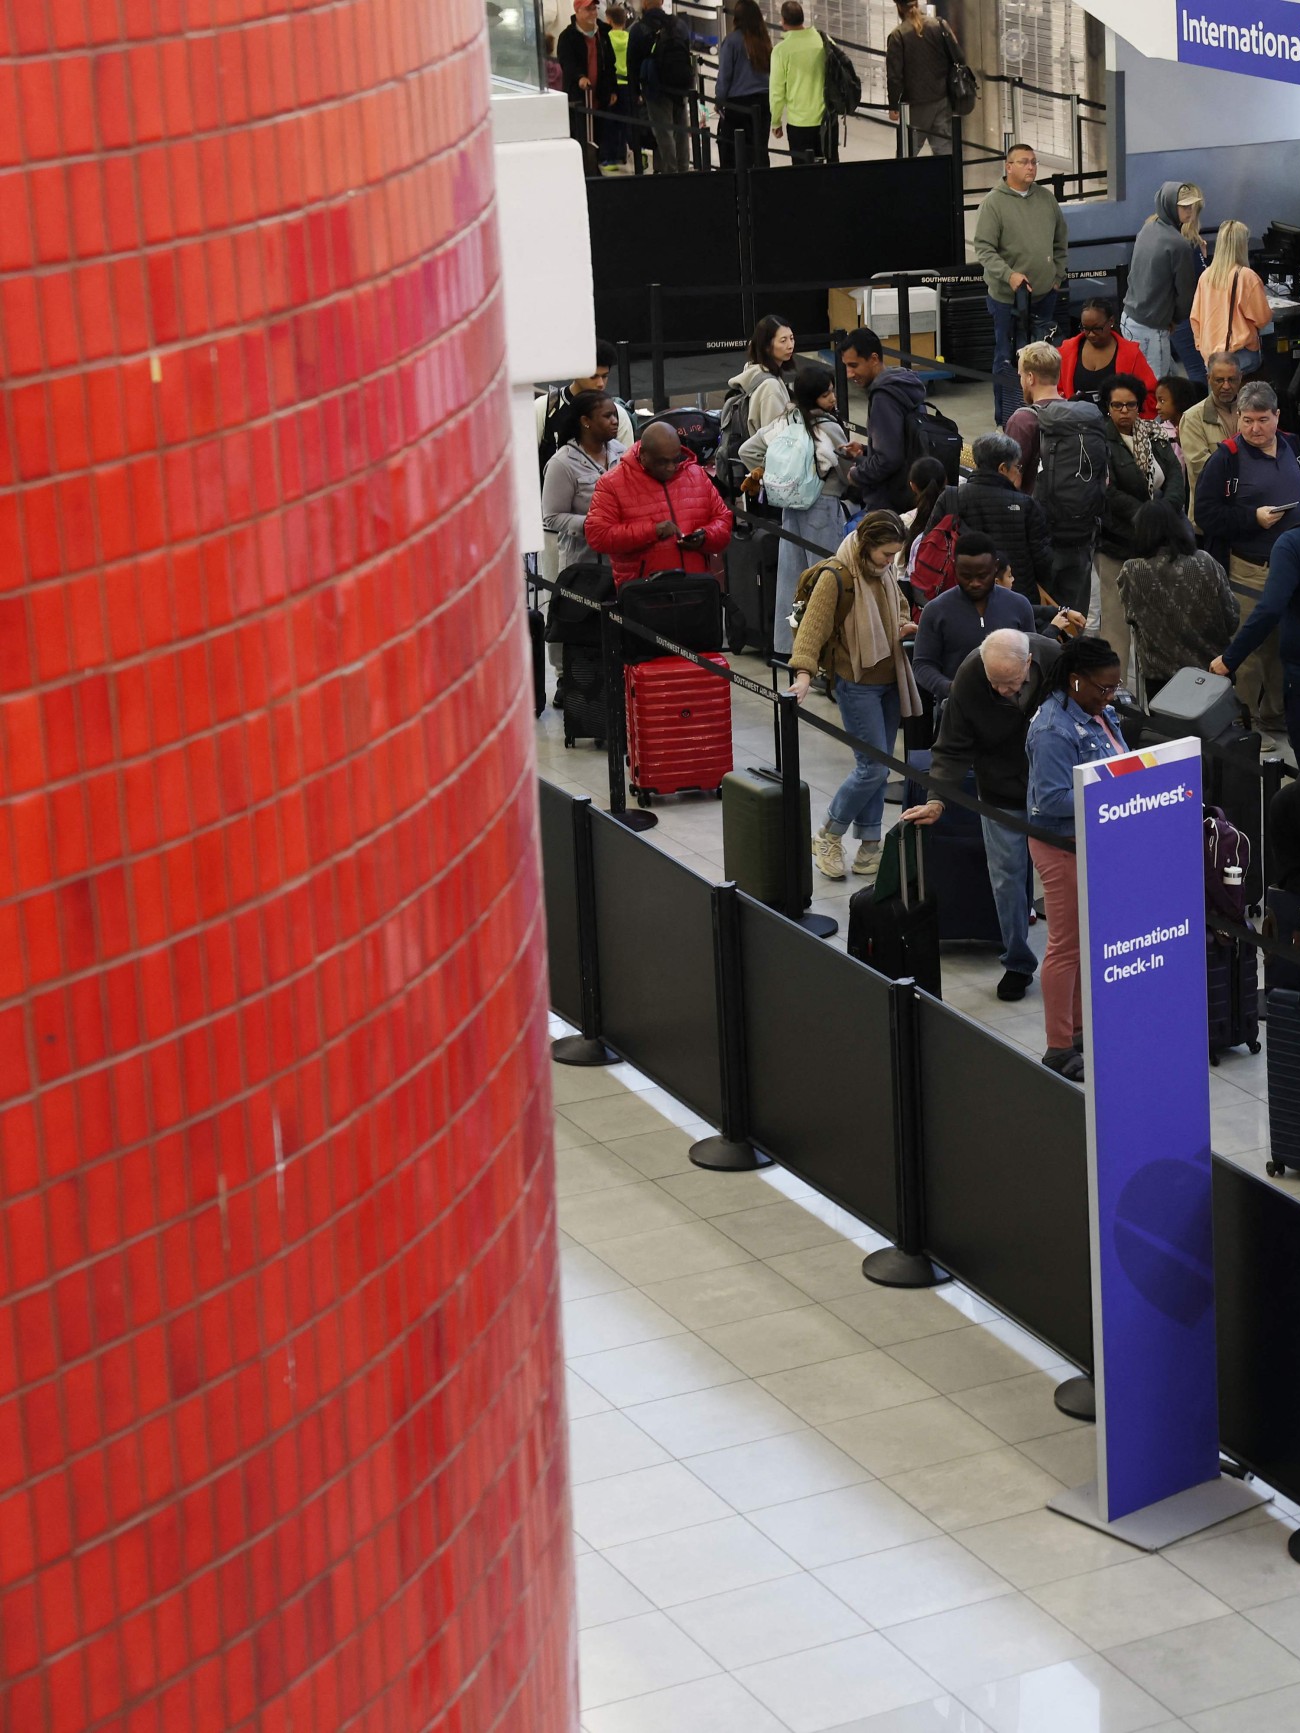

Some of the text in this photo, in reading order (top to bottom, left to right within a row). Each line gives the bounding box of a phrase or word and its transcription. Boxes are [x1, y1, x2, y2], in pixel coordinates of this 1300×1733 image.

[706, 340, 747, 349] SOUTHWEST
[560, 587, 584, 604] SOUTHWEST
[656, 635, 699, 664] SOUTHWEST AIRLINES
[733, 674, 779, 702] SOUTHWEST AIRLINES
[1098, 784, 1185, 824] Southwest
[1103, 918, 1189, 960] International
[1103, 953, 1164, 983] Check-In
